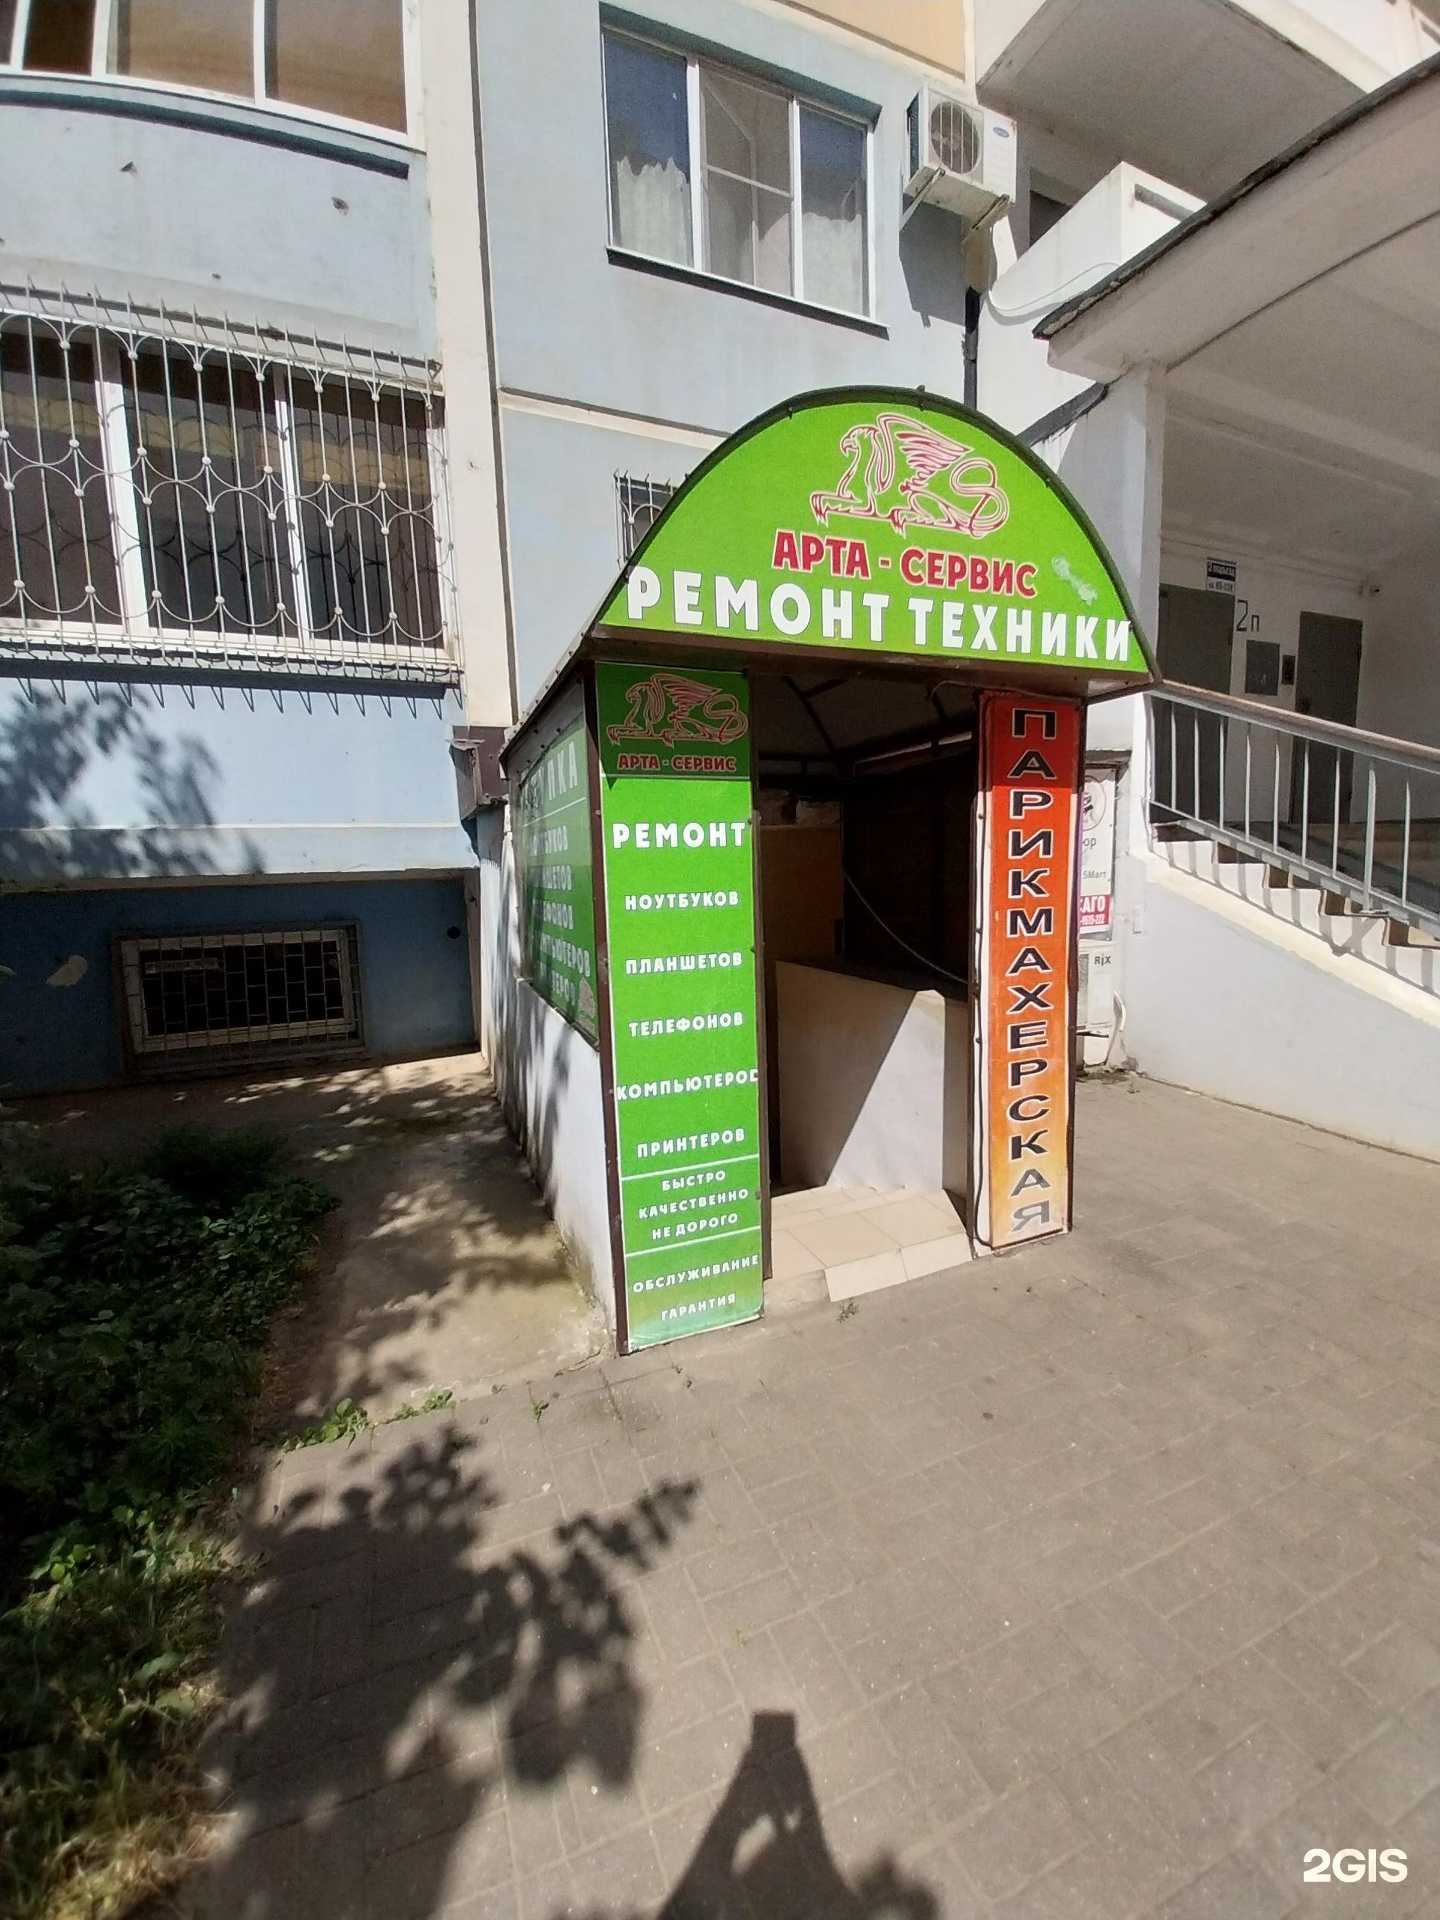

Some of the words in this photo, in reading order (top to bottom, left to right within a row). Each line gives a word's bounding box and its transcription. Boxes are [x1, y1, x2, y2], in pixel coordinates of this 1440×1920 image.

[772, 530, 870, 580] АРТА
[900, 547, 1038, 598] СЕРВИС
[627, 566, 889, 642] РЕМОНТ
[908, 598, 1131, 662] ТЕХНИКИ
[617, 753, 661, 771] АРТА
[671, 754, 737, 772] СЕРВИС
[612, 822, 746, 849] РЕМОНТ
[625, 891, 739, 911] НОУТБУКОВ
[625, 952, 743, 975] ПЛАНШЕТОВ
[1006, 707, 1056, 1233] ПАРИКМАХЕРСКАЯ
[629, 1012, 743, 1037] ТЕЛЕФОНОВ
[637, 1128, 745, 1159] ПРИНТЕРОВ
[661, 1170, 726, 1191] БЫСТРО
[638, 1188, 749, 1219] КАЧЕСТВЕННО
[652, 1226, 671, 1240] НЕ
[675, 1213, 738, 1237] ДОРОГО
[632, 1255, 759, 1293] ОБСЛУЖИВАНИЕ
[660, 1293, 736, 1321] ГАРАНТИЯ
